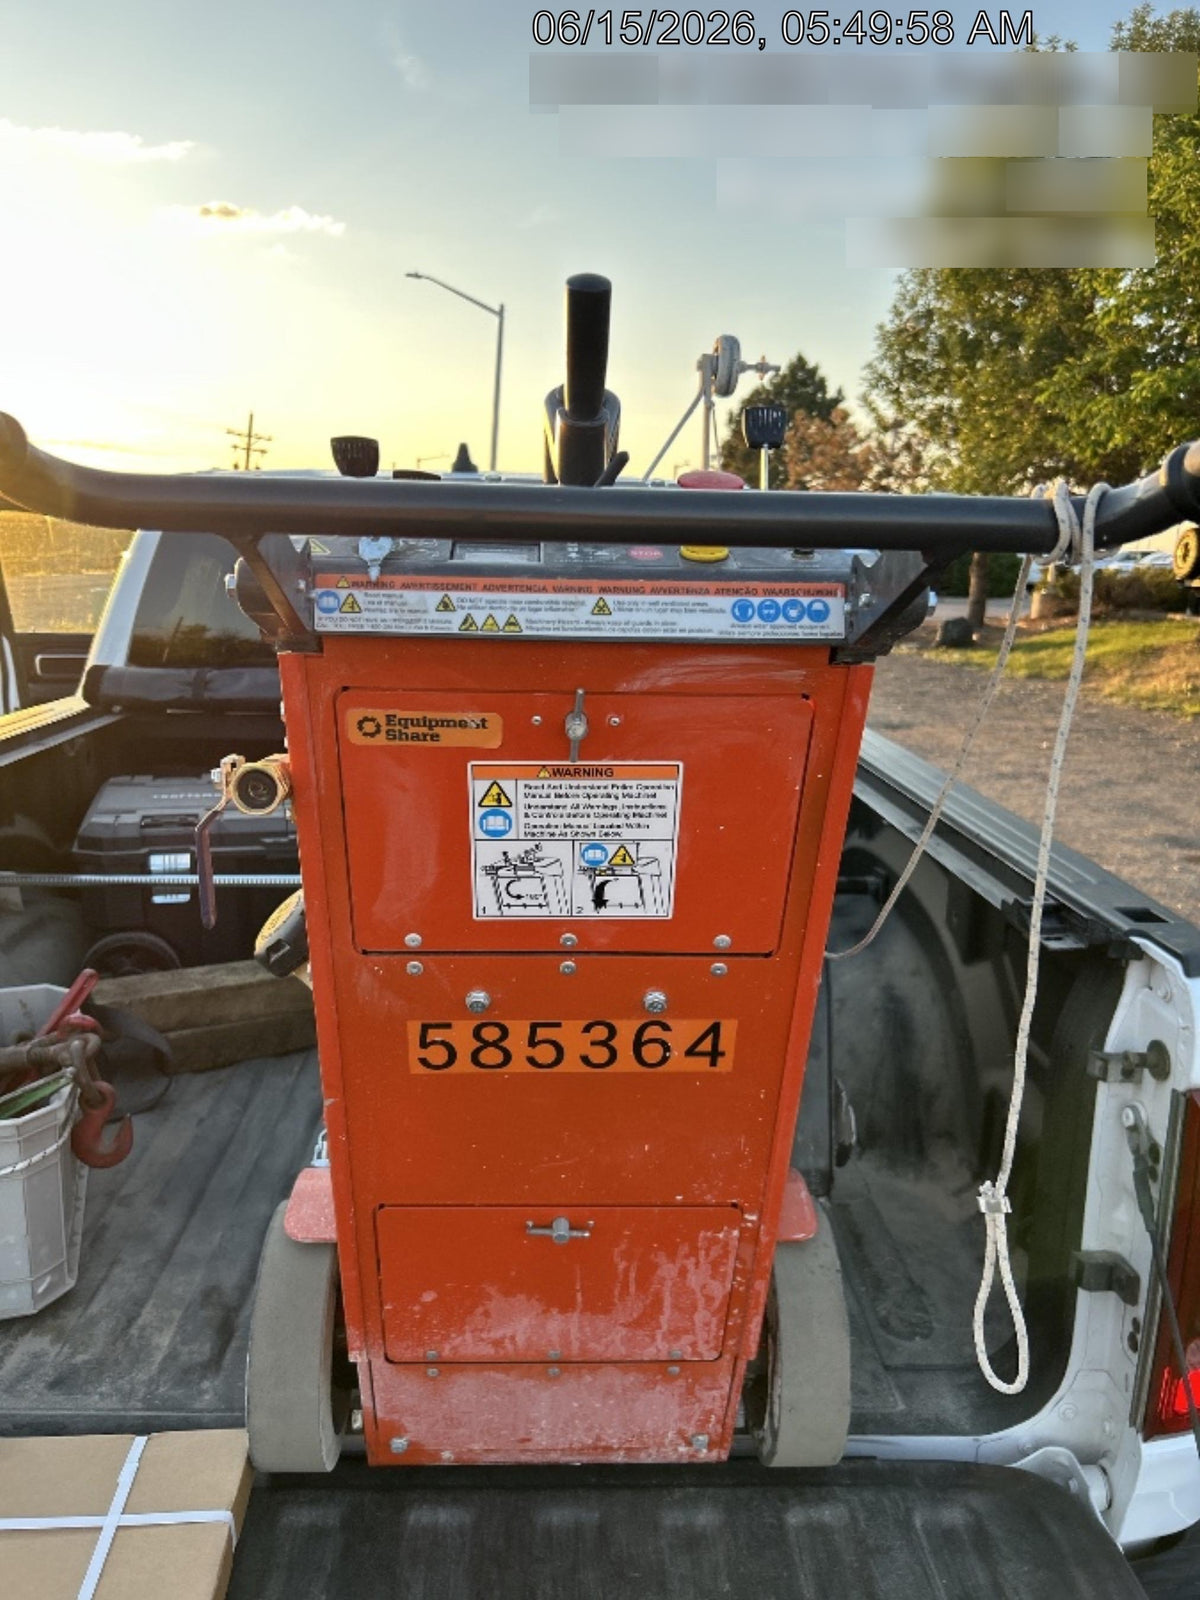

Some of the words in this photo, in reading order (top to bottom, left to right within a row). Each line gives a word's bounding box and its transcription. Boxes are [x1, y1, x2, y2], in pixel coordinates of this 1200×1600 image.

[351, 580, 395, 589] WARNING
[482, 583, 548, 593] ADVERTENCIA
[598, 585, 646, 594] WARNUNG
[650, 586, 710, 595] AVVERTENZA
[385, 729, 440, 742] Share
[552, 767, 614, 778] WARNING
[481, 906, 487, 915] 1
[576, 906, 584, 914] 2
[417, 1020, 726, 1071] 585364
